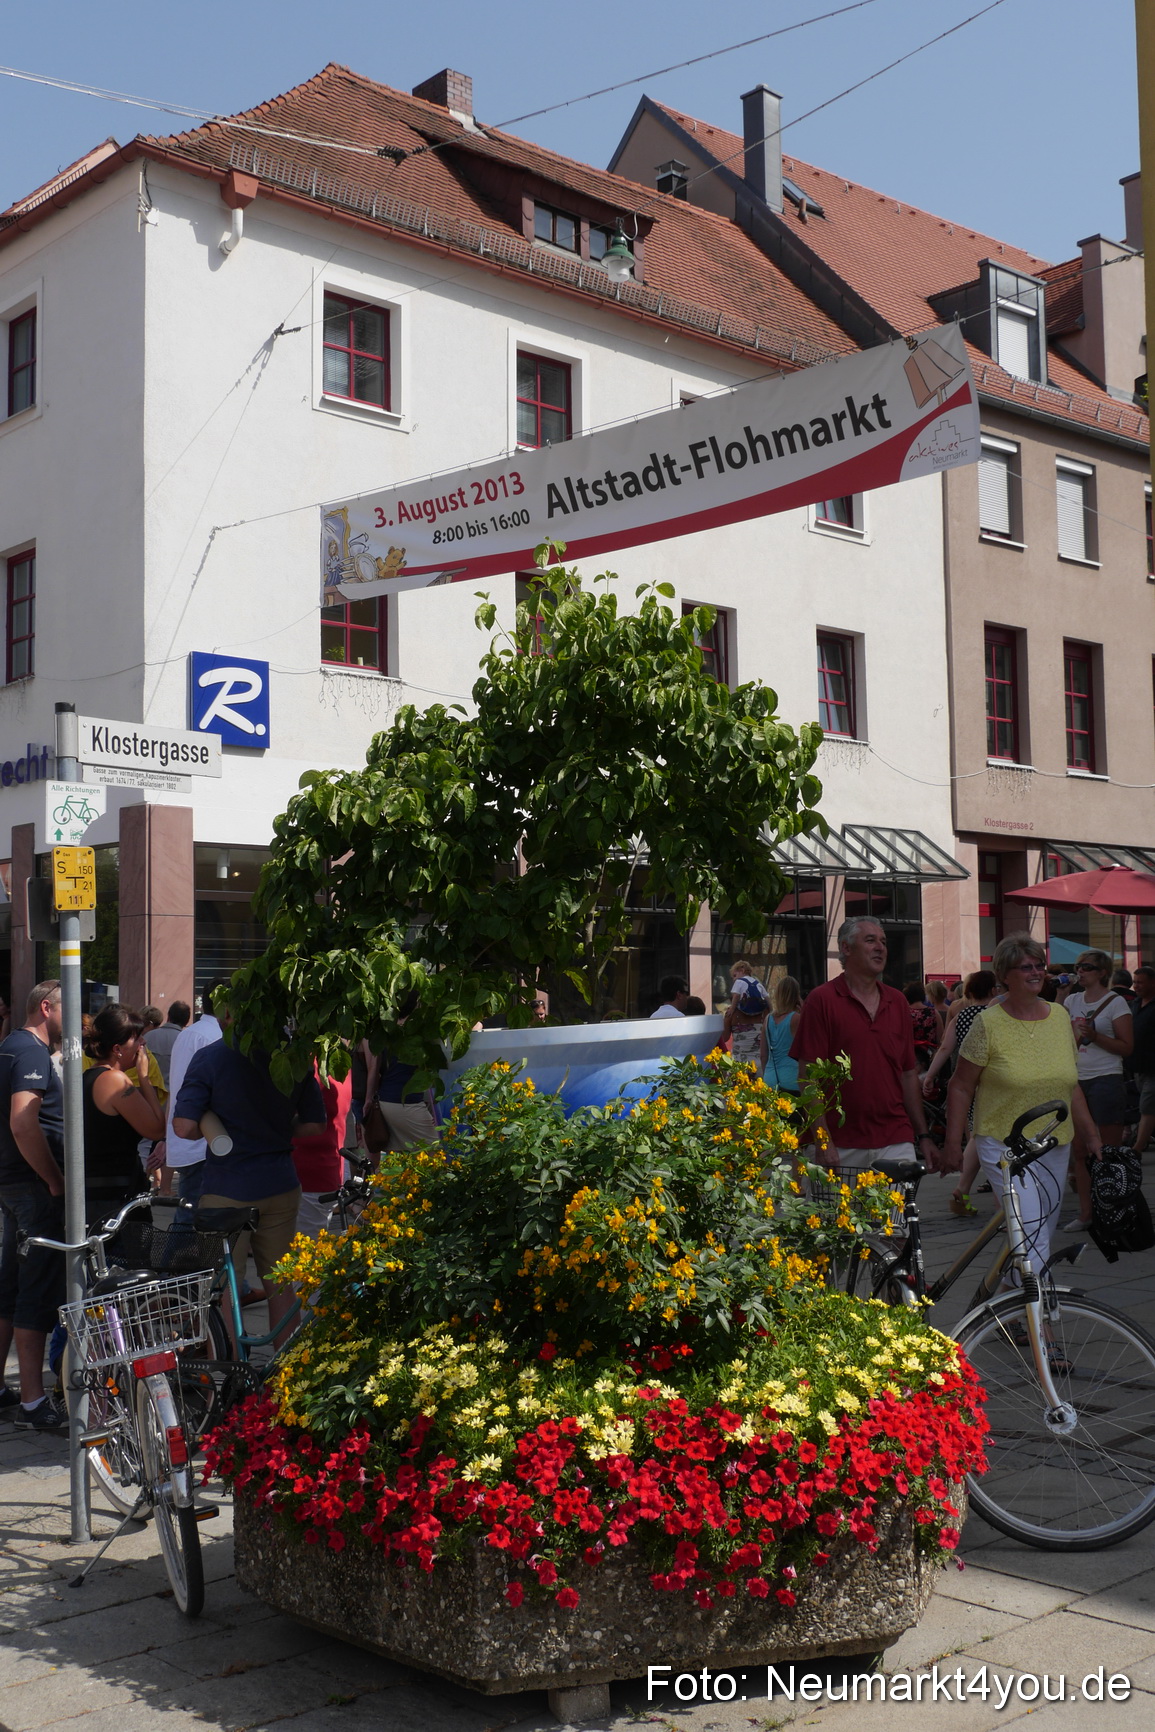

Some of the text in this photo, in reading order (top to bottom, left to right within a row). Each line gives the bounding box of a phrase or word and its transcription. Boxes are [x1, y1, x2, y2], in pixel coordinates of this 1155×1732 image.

[547, 392, 892, 519] Altstadt-Flohmarkt
[909, 441, 958, 463] aktives
[932, 449, 968, 465] Neumarkt
[374, 471, 526, 528] 3. August 2013
[432, 508, 531, 545] 8:00 bis 16:00
[92, 725, 209, 767] Klostergasse
[93, 766, 106, 775] Gasse
[51, 784, 101, 795] Alle Richtungen
[99, 776, 115, 784] erbaut
[166, 782, 177, 790] 1802
[984, 817, 1034, 830] Klostergasse 2
[57, 861, 66, 874] S
[78, 865, 93, 875] 150
